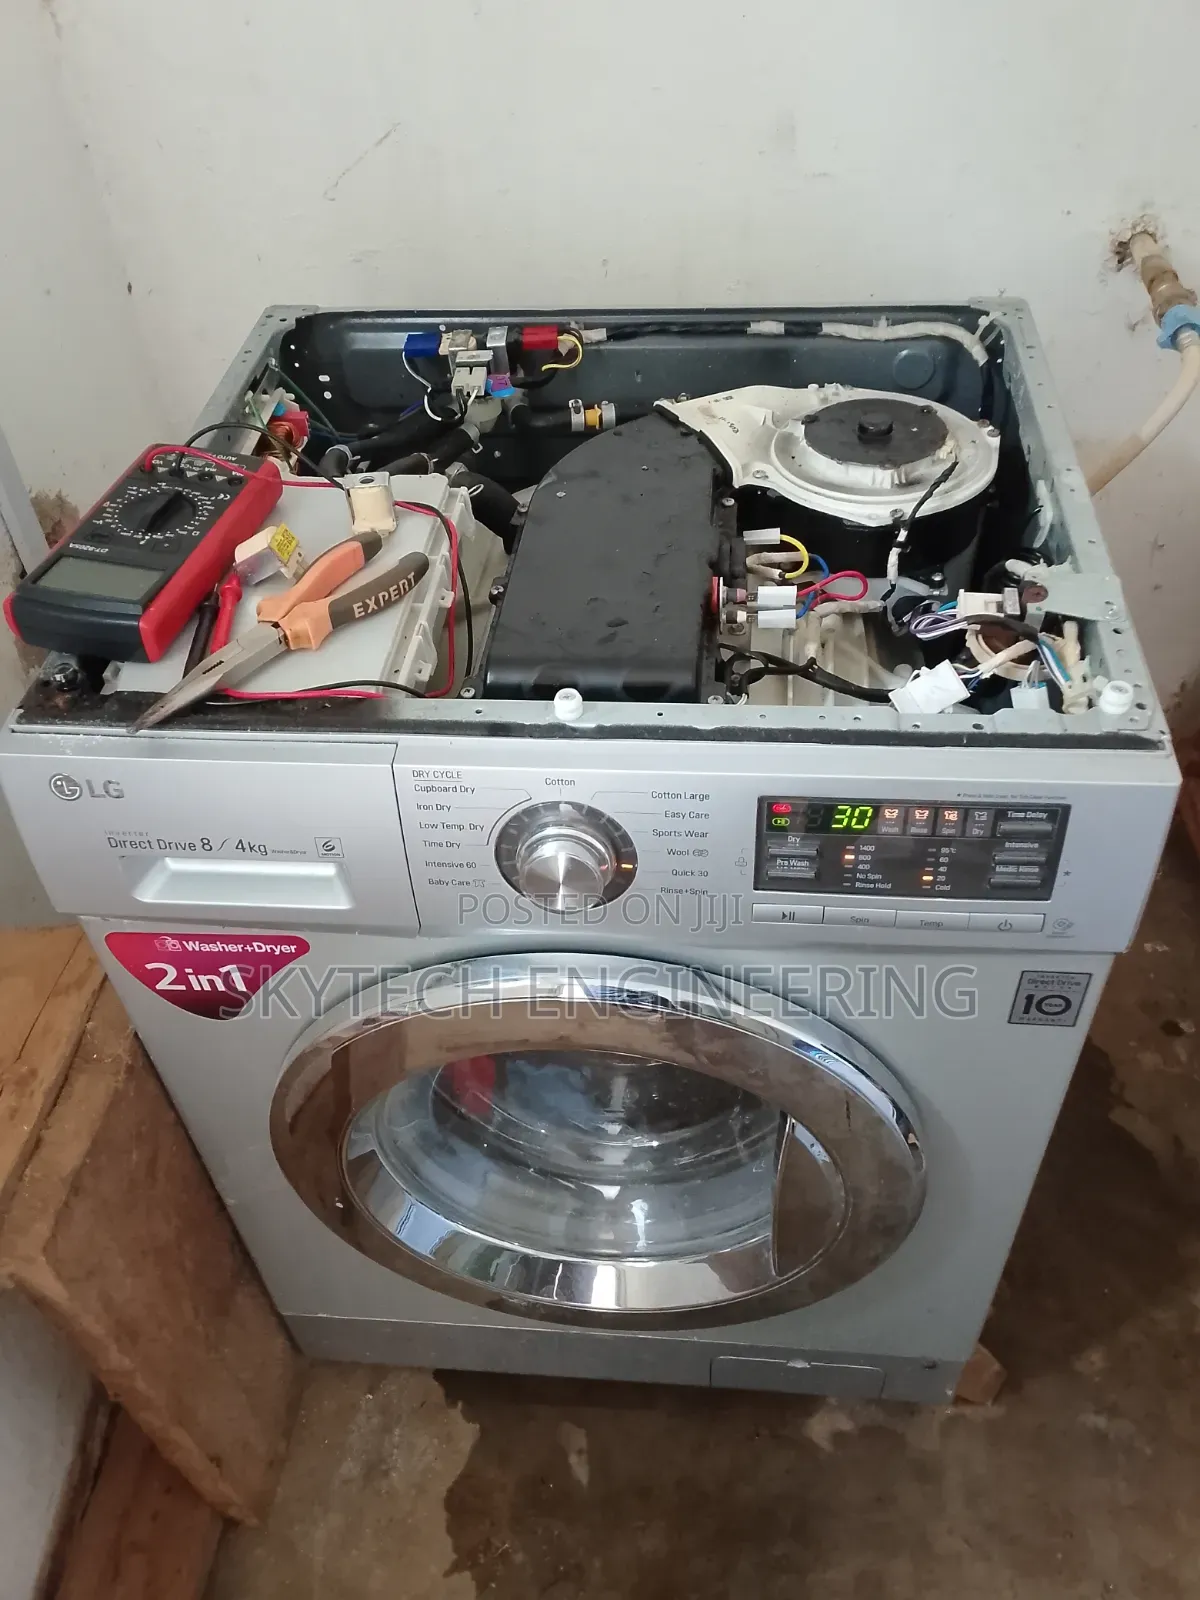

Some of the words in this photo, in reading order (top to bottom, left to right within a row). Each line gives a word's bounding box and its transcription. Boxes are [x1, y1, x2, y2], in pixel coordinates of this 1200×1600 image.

[352, 571, 415, 619] EXPERT
[412, 769, 429, 779] DRY
[432, 770, 462, 780] CYCLE
[544, 777, 576, 786] Cotton
[85, 778, 125, 799] LG
[414, 784, 458, 793] Cupboard
[459, 785, 476, 795] Dry
[651, 790, 682, 800] Cotton
[683, 791, 711, 802] Large
[416, 802, 434, 811] Iron
[435, 803, 452, 813] Dry
[664, 810, 687, 820] Easy
[688, 811, 710, 820] Care
[831, 804, 874, 829] 30
[419, 821, 438, 830] Low
[469, 823, 485, 832] Dry
[652, 828, 683, 838] Sports
[684, 830, 709, 839] Wear
[787, 835, 801, 844] Dry
[107, 836, 154, 850] Direct
[156, 838, 197, 852] Drive
[199, 837, 213, 852] 8
[235, 838, 269, 857] 4kg
[422, 840, 443, 848] Time
[445, 840, 461, 850] Dry
[859, 844, 876, 852] 1400
[666, 848, 690, 857] Wool
[425, 860, 465, 869] Intensive
[466, 861, 477, 869] 60
[790, 860, 811, 868] Wash
[857, 863, 871, 871] 400
[671, 868, 696, 878] Quick
[697, 870, 709, 878] 30
[856, 872, 867, 880] No
[868, 873, 883, 882] Spin
[428, 878, 450, 888] Baby
[451, 880, 471, 888] Care
[855, 881, 875, 890] Rinse
[875, 882, 892, 890] Hold
[934, 884, 952, 892] Cold
[850, 915, 870, 925] Spin
[919, 919, 944, 929] Temp
[183, 940, 297, 955] Washer+Dryer
[1022, 993, 1073, 1016] 10
